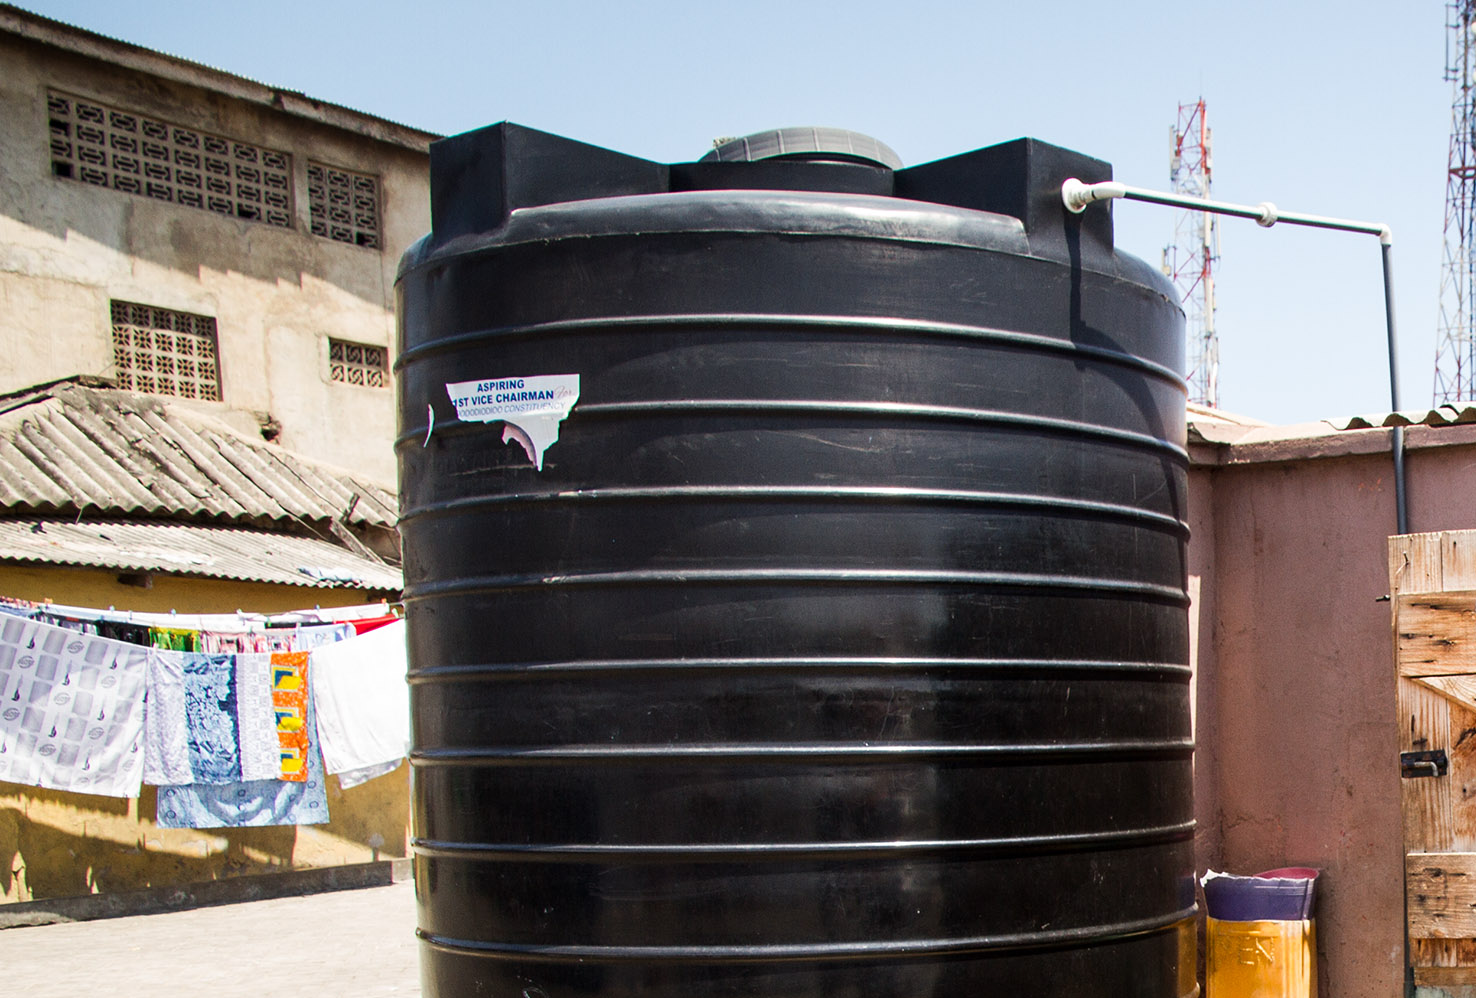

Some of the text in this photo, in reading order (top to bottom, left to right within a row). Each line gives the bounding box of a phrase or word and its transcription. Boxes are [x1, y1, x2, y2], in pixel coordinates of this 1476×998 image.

[477, 379, 525, 393] ASPIRING
[471, 394, 493, 405] VICE
[495, 390, 554, 403] CHAIRMAN
[504, 402, 566, 413] CONSTITUENCY
